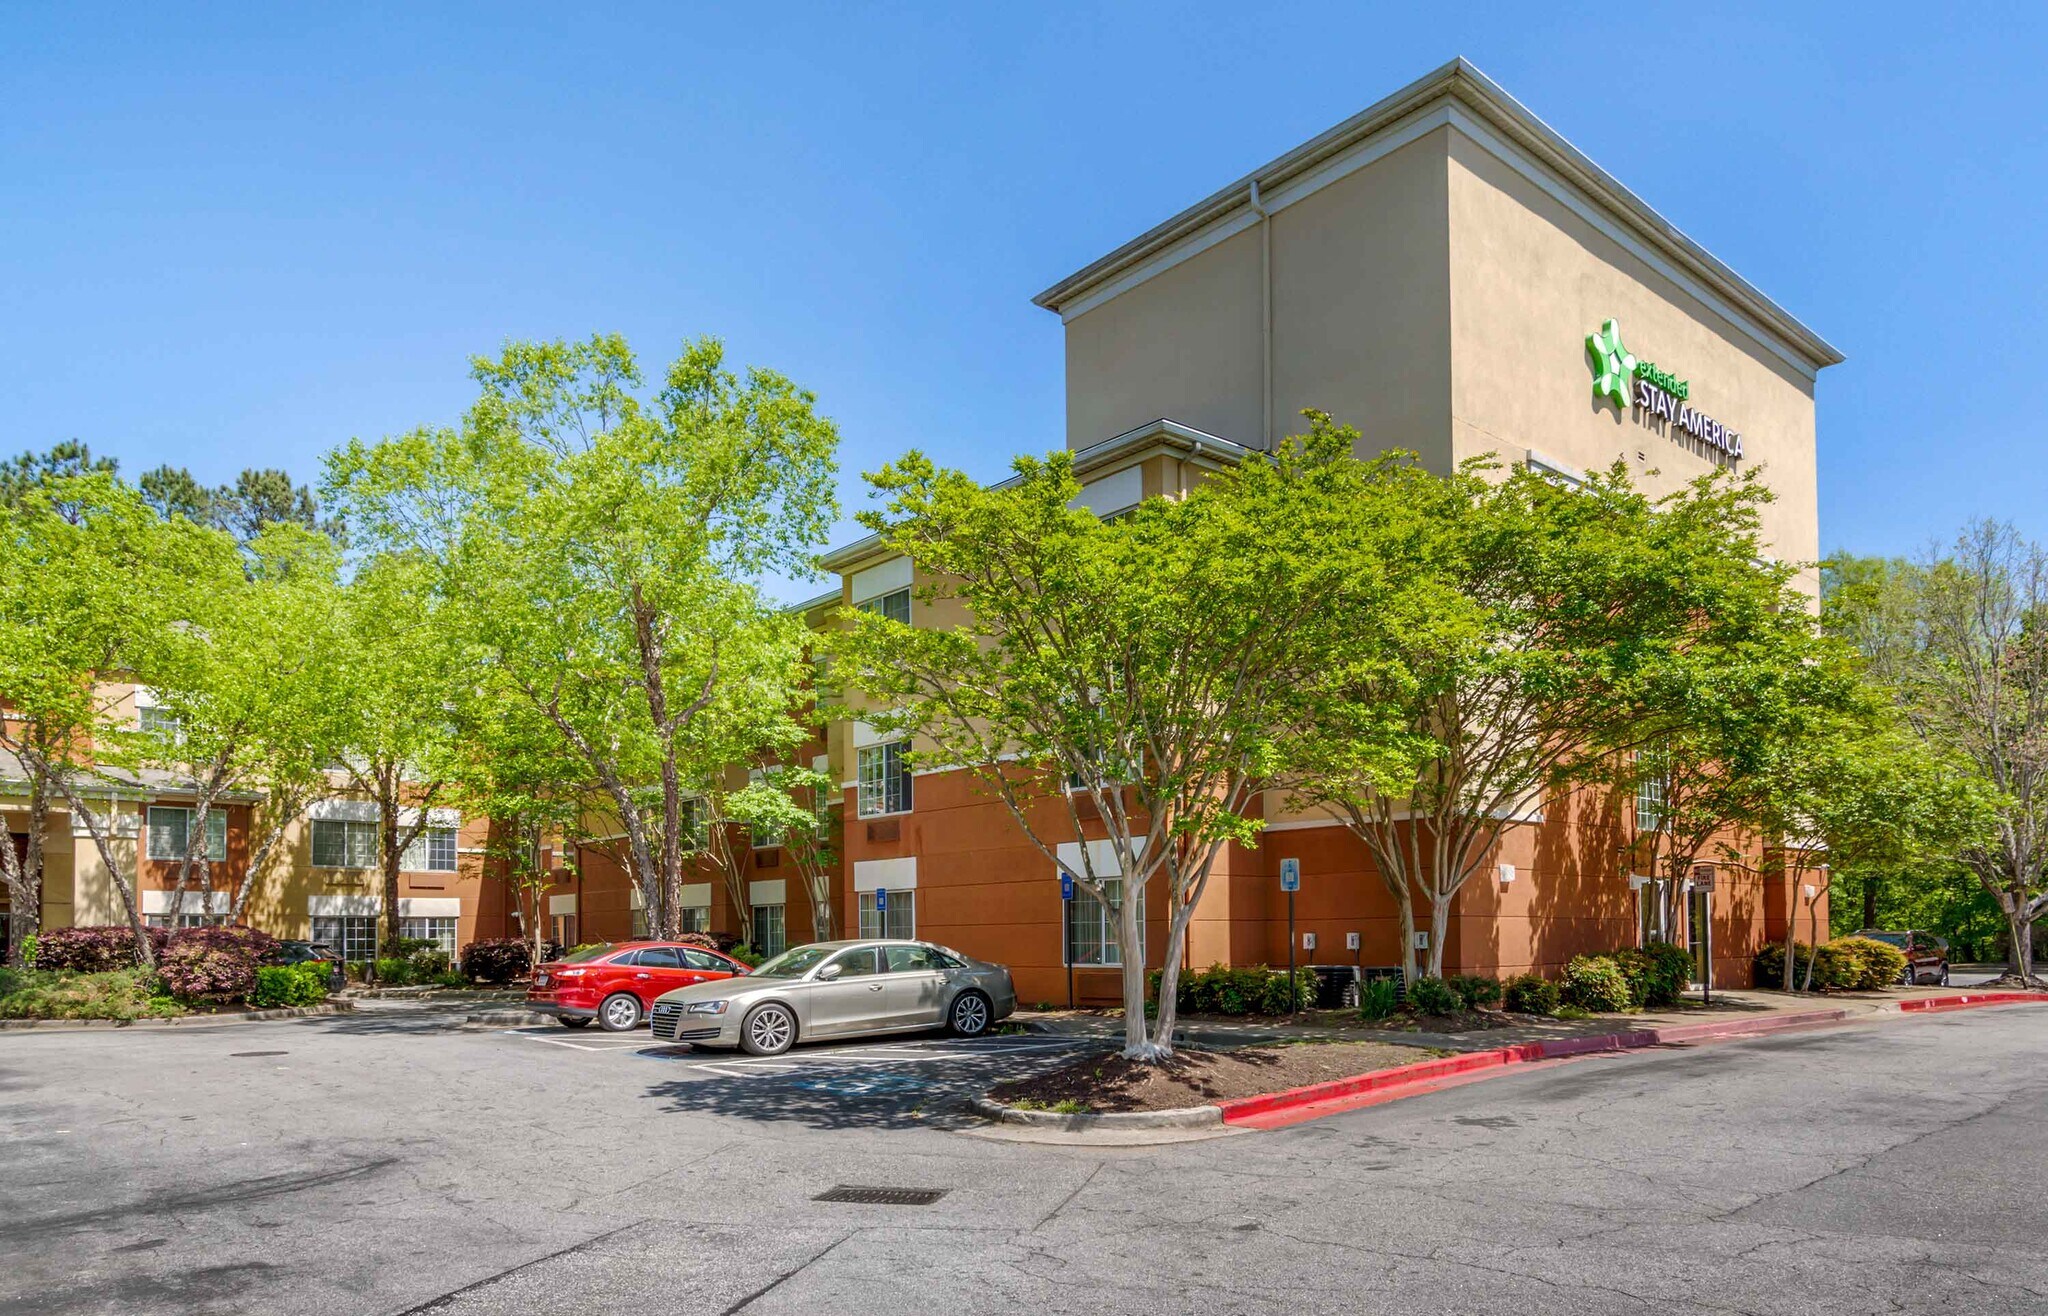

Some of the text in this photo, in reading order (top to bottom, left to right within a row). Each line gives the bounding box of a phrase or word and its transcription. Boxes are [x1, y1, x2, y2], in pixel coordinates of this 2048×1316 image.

[1639, 361, 1689, 400] extended
[1638, 380, 1744, 460] STAY AMERICA
